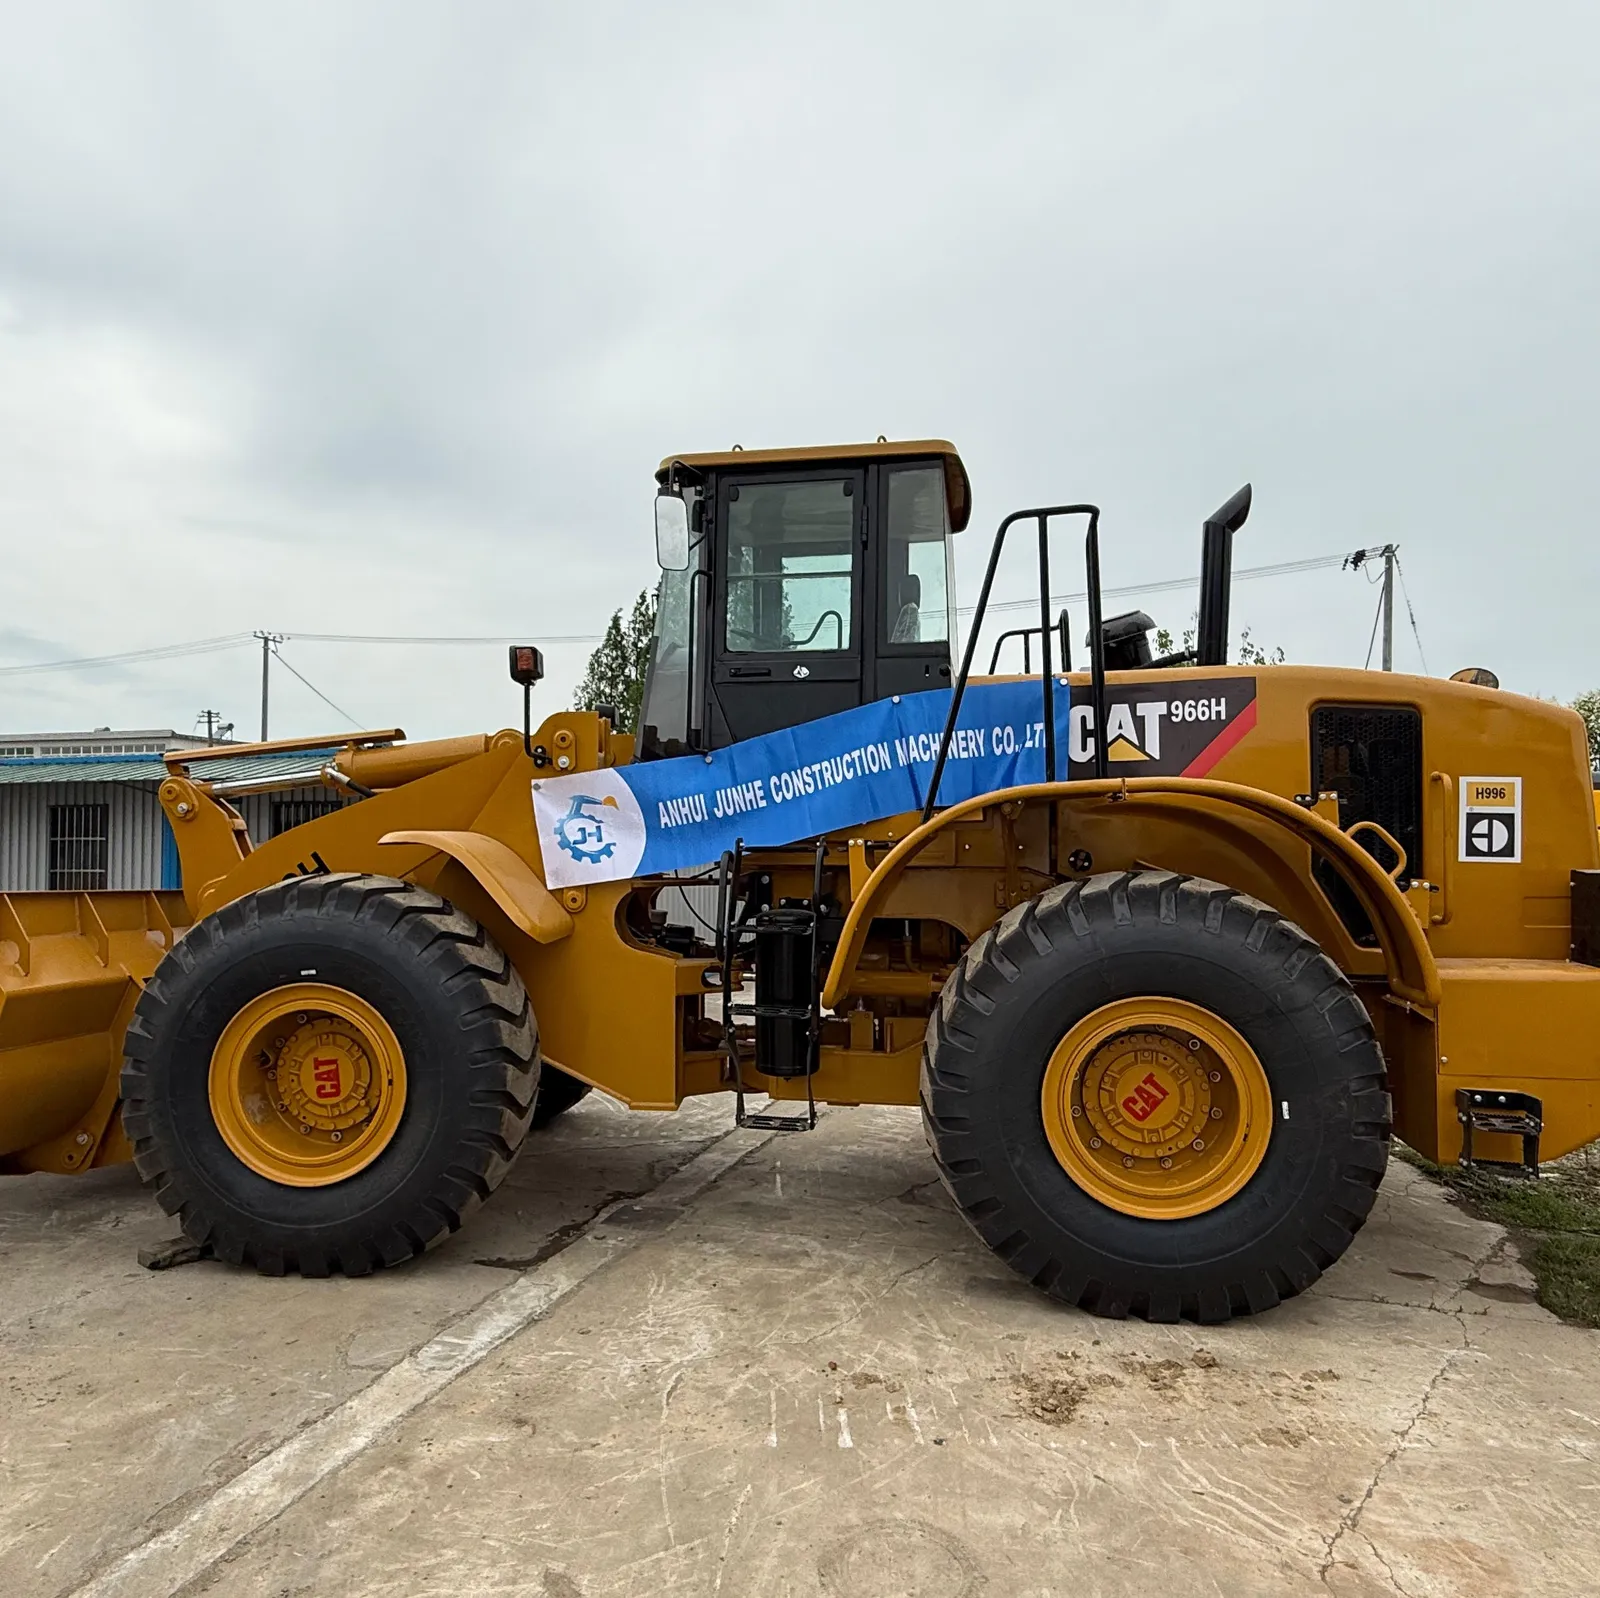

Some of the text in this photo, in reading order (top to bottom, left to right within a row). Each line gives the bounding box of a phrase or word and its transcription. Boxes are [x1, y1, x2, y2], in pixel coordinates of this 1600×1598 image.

[1068, 697, 1226, 763] CAT 966H
[658, 793, 709, 829] ANHUI
[713, 779, 768, 819] JUNHE
[769, 741, 892, 804] CONSTRUCTION
[894, 728, 985, 767] MACHNERY
[1024, 722, 1046, 748] LT
[1475, 787, 1507, 800] H996
[313, 1056, 341, 1099] CAT
[1122, 1071, 1170, 1122] CAT
